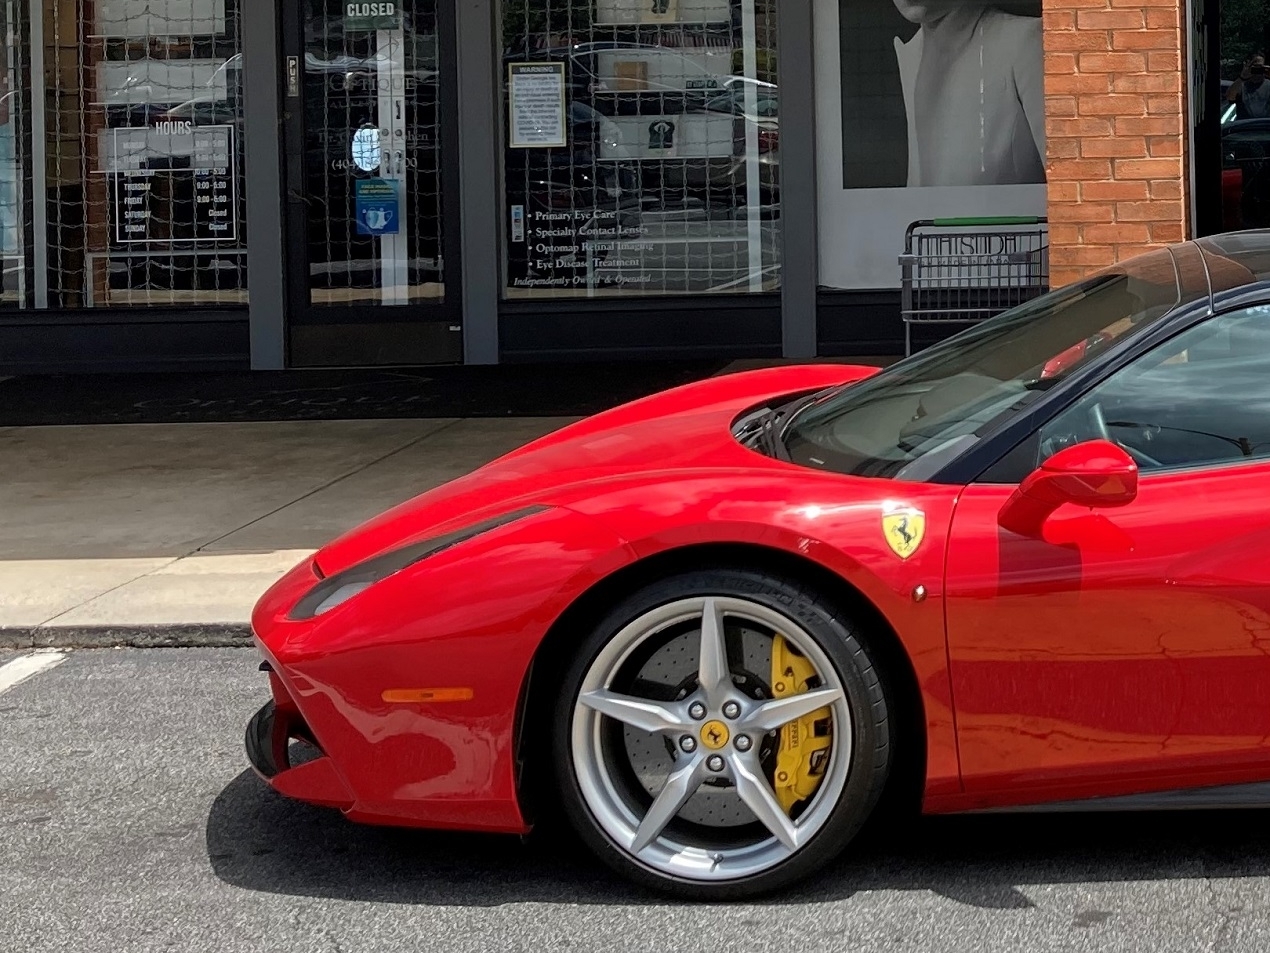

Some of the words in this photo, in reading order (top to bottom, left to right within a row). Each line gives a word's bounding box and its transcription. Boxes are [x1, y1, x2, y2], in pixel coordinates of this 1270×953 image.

[346, 2, 395, 17] CLOSED
[155, 120, 192, 135] HOURS
[535, 211, 572, 222] Primary
[574, 210, 591, 221] Eye
[593, 209, 616, 220] Care
[535, 227, 577, 239] Specialty
[578, 226, 616, 237] Contact
[618, 224, 649, 235] Lenses
[535, 243, 580, 255] Optomap
[536, 259, 553, 270] Eye
[555, 258, 590, 268] Disease
[592, 257, 640, 267] Treatment
[514, 275, 572, 287] Independently
[615, 273, 652, 286] Operated
